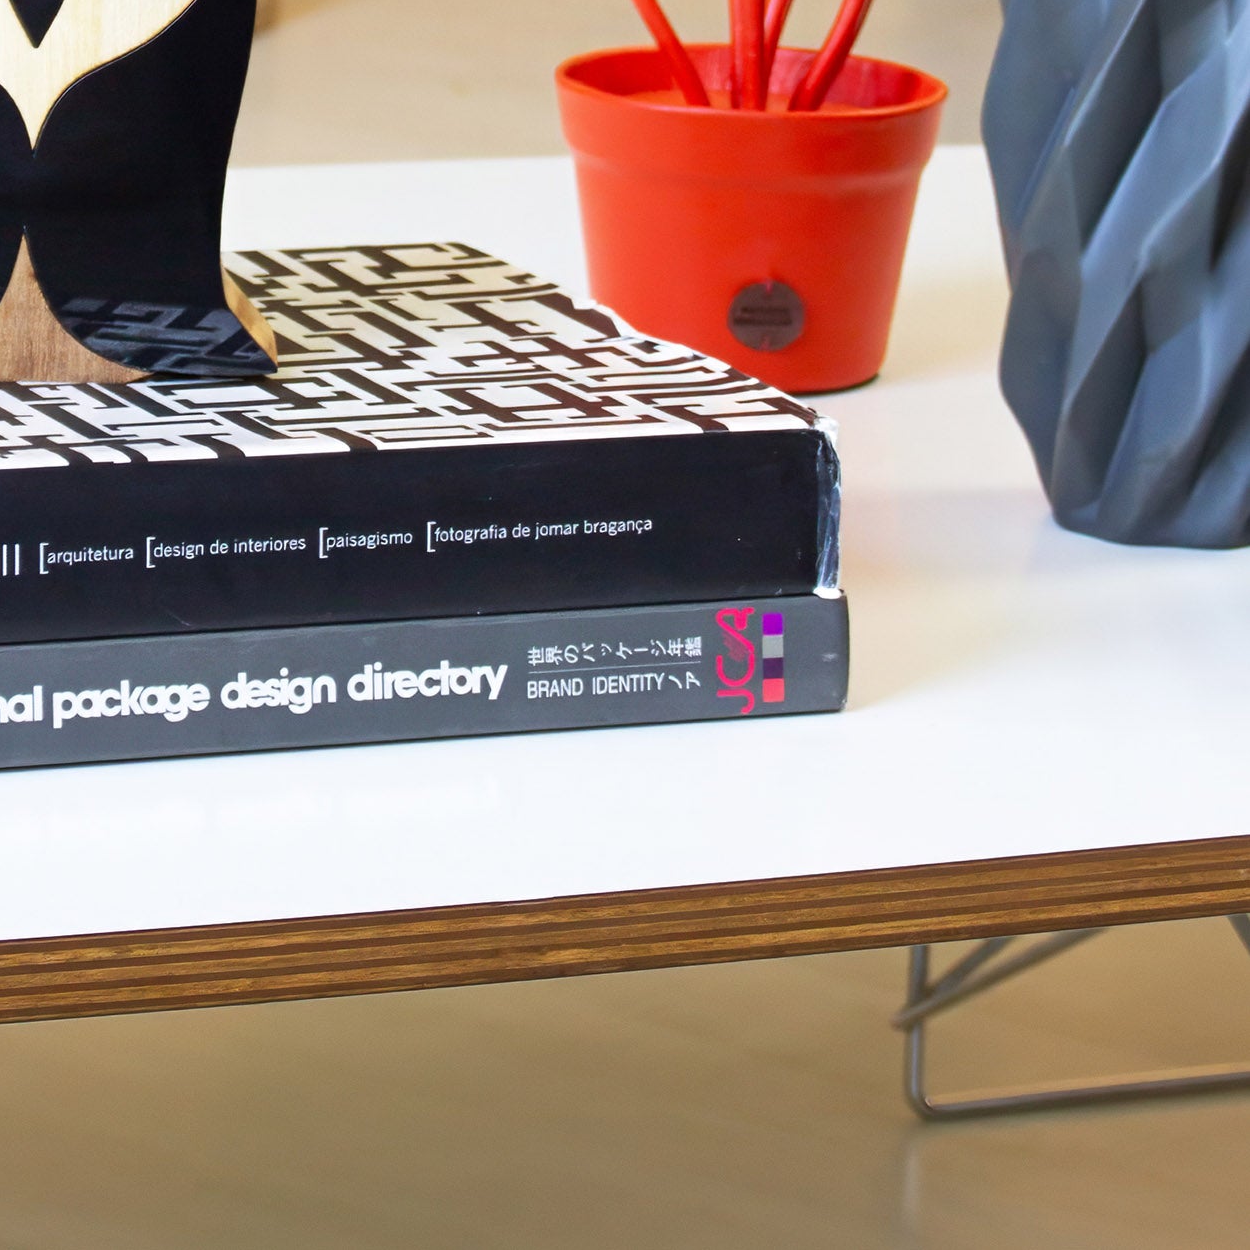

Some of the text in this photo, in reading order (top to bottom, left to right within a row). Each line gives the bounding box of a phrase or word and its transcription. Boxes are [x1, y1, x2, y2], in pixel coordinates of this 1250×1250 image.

[209, 538, 229, 556] de
[233, 536, 307, 555] interiores
[511, 522, 531, 539] de
[534, 521, 579, 541] jomar
[583, 517, 653, 537] bragança
[52, 679, 211, 729] package
[220, 666, 337, 715] design
[346, 659, 509, 701] directory
[526, 672, 665, 699] BRAND IDENTITY
